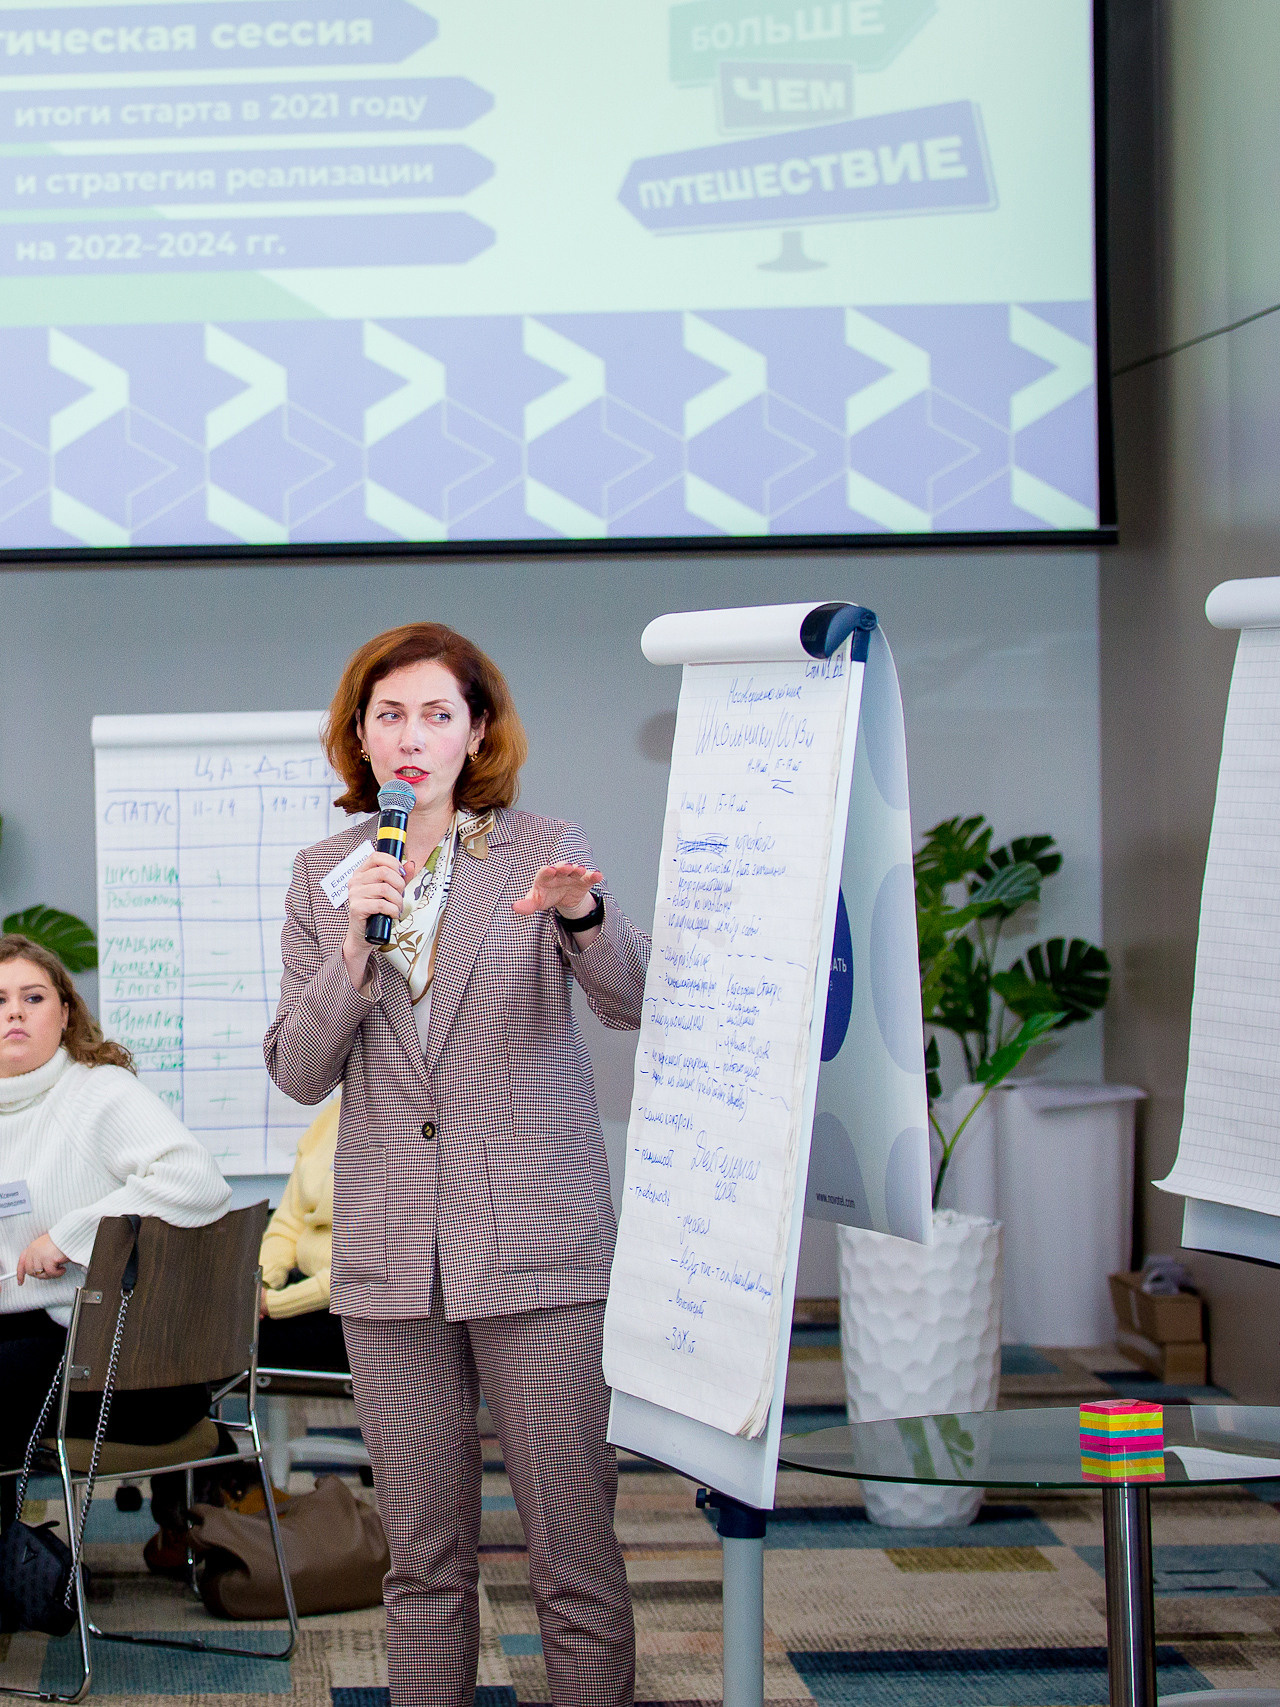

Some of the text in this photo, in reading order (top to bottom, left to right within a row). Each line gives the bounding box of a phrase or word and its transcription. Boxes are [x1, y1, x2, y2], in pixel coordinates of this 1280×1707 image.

[210, 18, 374, 49] сессия
[690, 0, 886, 52] БОЛЬШЕ
[14, 93, 428, 128] итоги старта в 2021 году
[732, 76, 846, 113] ЧЕМ
[14, 163, 435, 199] и стратегия реализации
[637, 135, 968, 209] ПУТЕШЕСТВИЕ
[15, 240, 57, 262] на
[246, 232, 287, 256] гг.
[104, 800, 177, 826] СТАТУС
[830, 957, 848, 973] АТЬ
